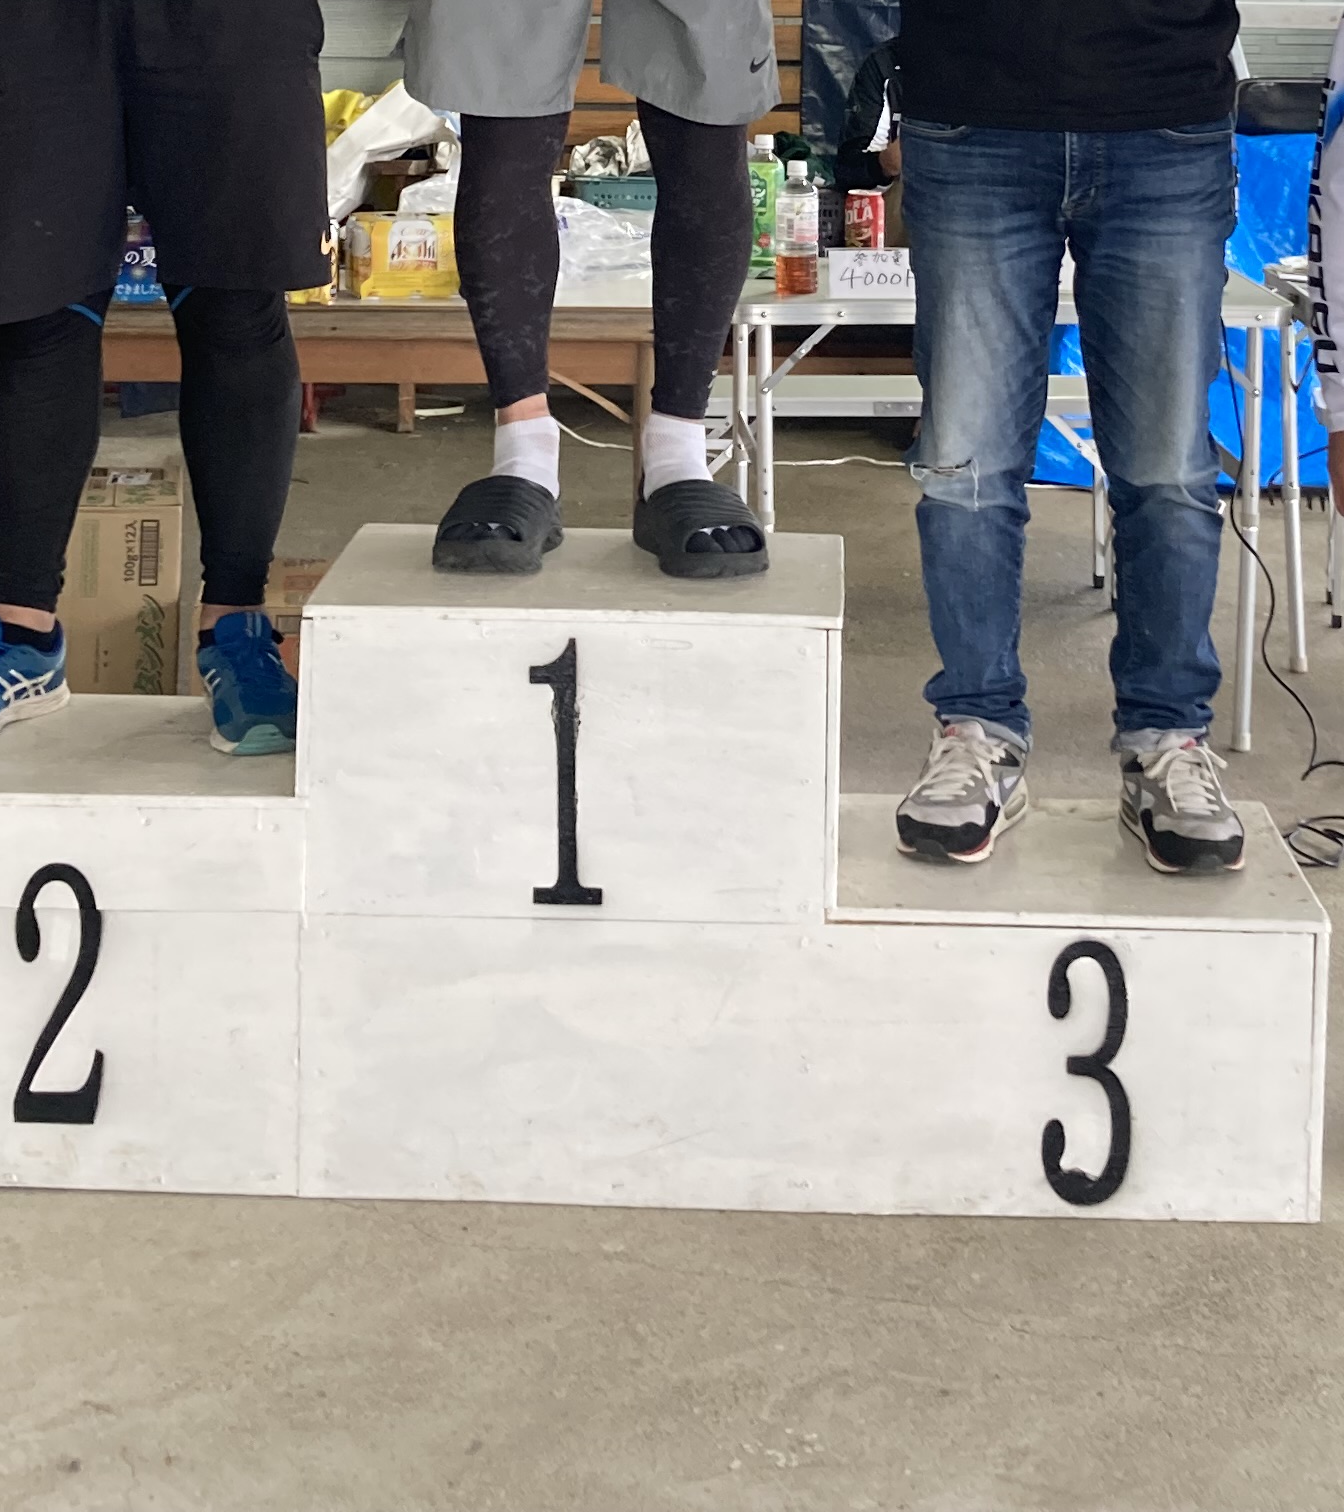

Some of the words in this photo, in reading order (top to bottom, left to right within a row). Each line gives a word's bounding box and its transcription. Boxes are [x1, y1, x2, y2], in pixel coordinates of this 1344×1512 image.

[529, 637, 603, 905] 1
[13, 863, 104, 1124] 2
[1041, 939, 1132, 1207] 3
